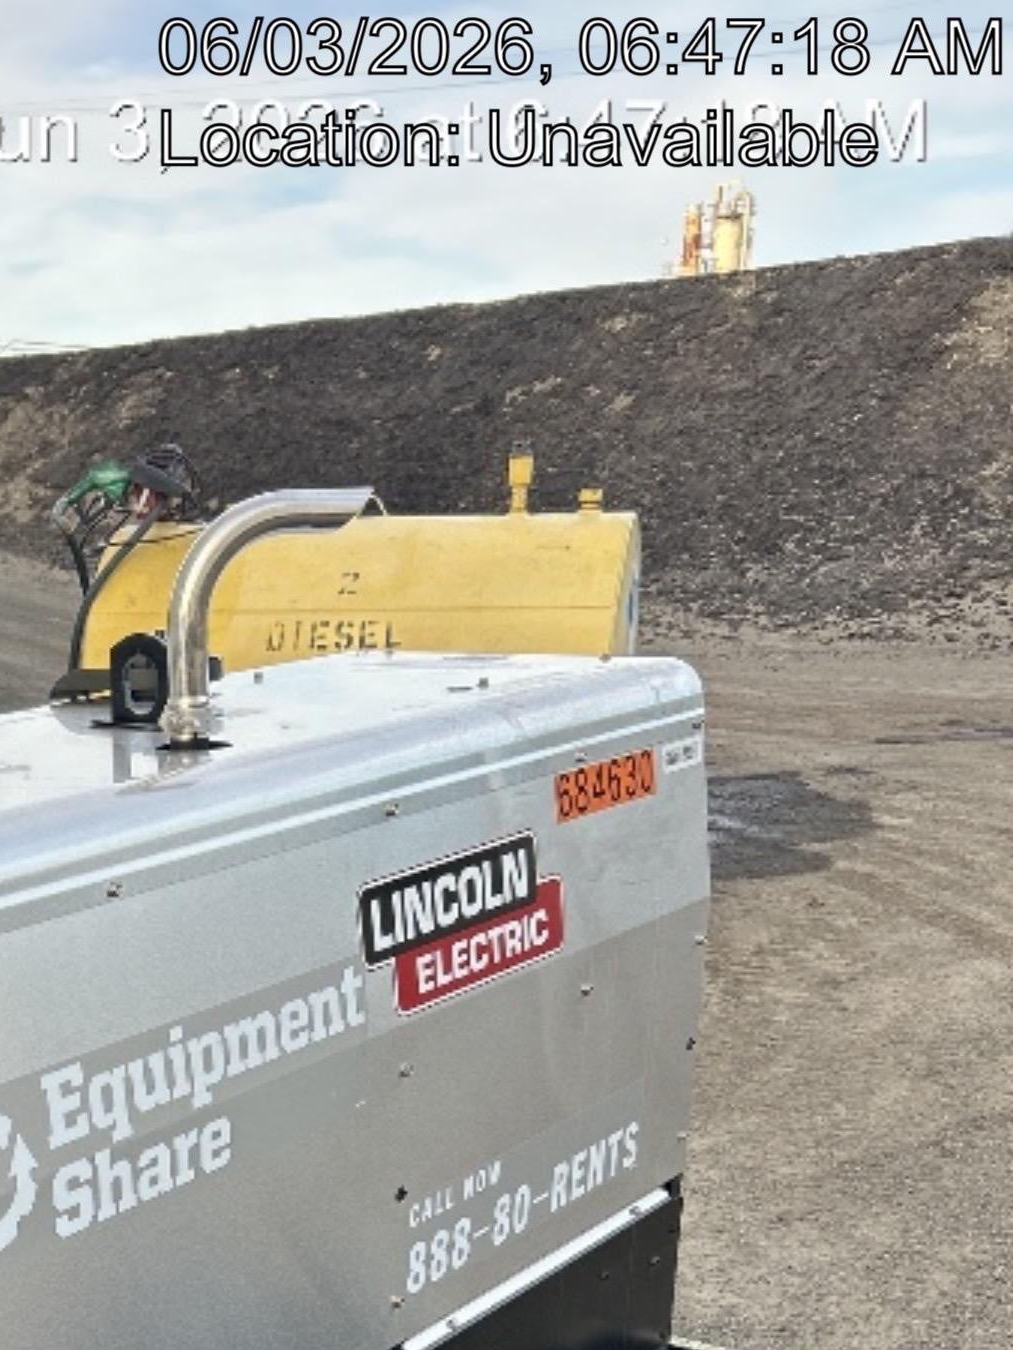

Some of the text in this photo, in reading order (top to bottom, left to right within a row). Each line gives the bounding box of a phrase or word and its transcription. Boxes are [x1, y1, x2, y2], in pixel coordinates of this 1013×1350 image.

[266, 620, 402, 652] DIESEL
[559, 749, 653, 817] 684630
[370, 848, 529, 952] LINCOLN
[415, 907, 549, 994] ELECTRIC
[40, 965, 366, 1150] Equipment
[51, 1114, 232, 1239] Share
[406, 1121, 639, 1294] 888-80-RENTS
[409, 1160, 502, 1228] CALL NOW
